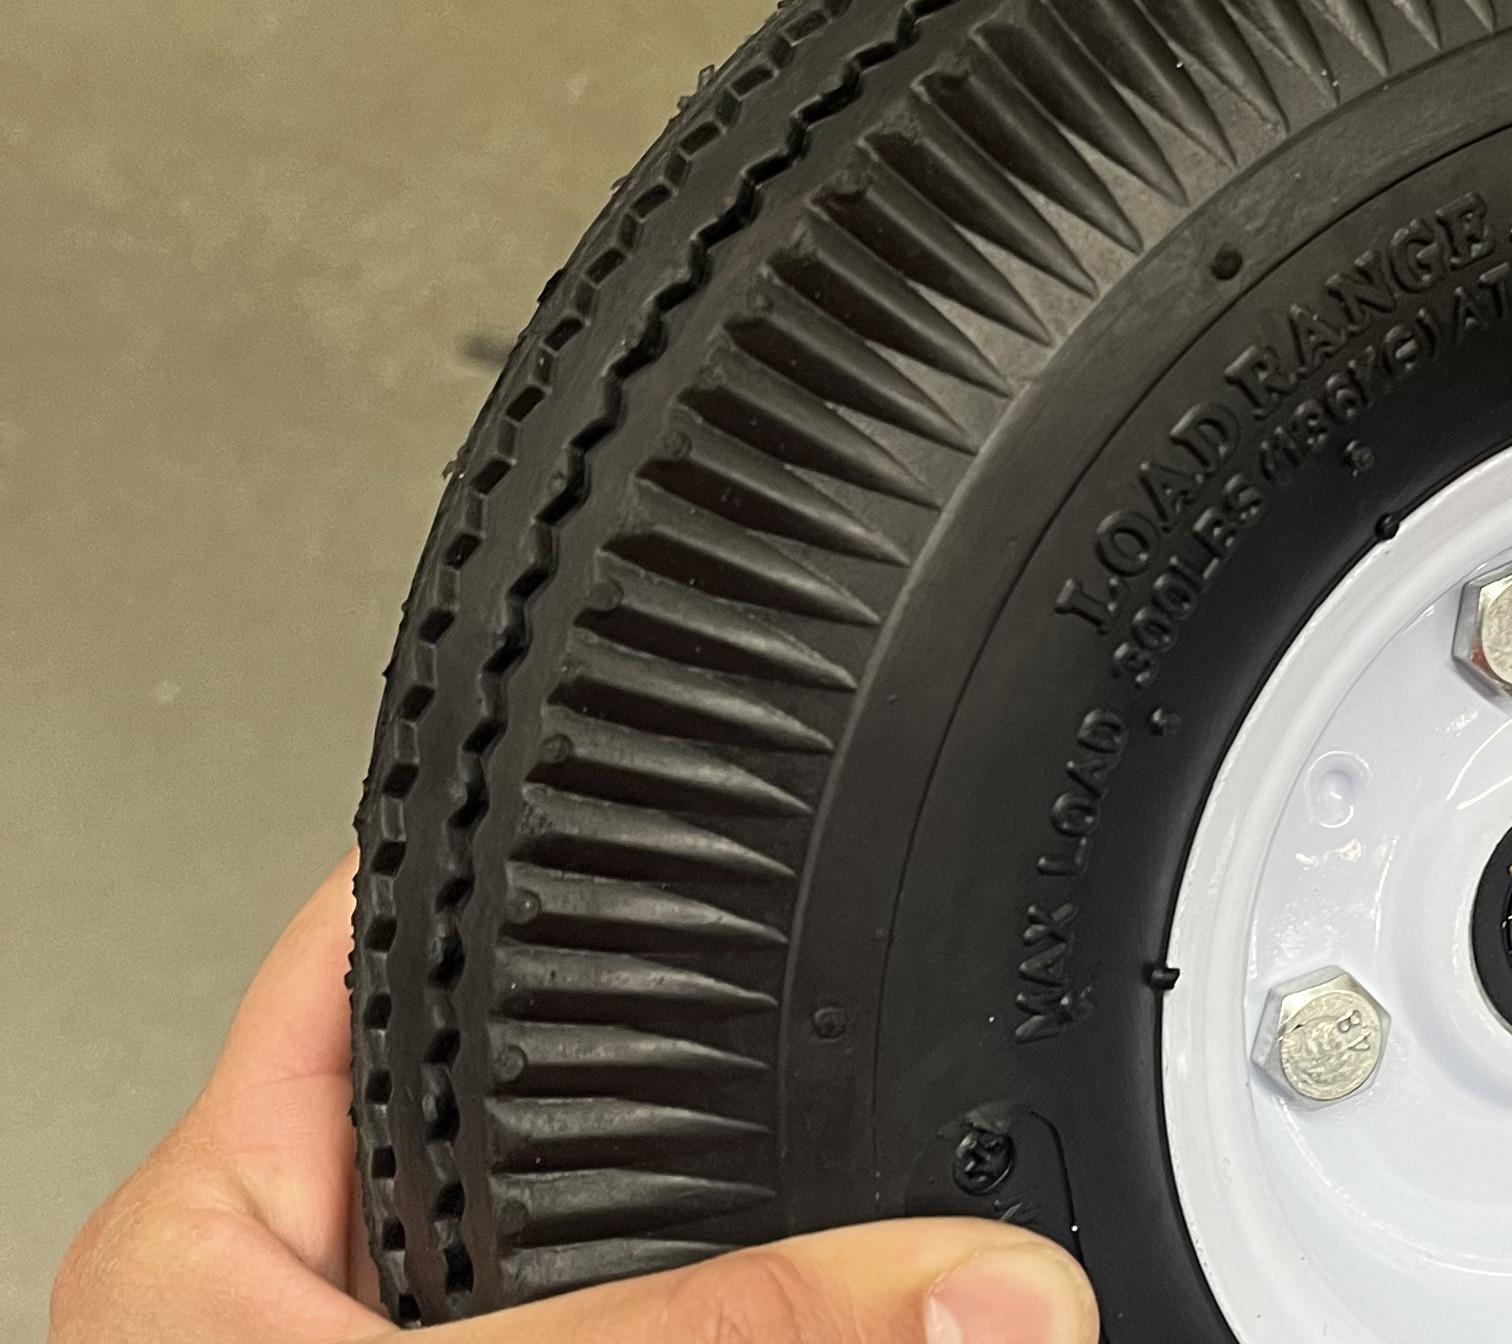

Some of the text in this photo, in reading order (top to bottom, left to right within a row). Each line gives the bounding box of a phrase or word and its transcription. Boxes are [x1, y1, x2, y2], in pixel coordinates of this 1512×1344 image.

[1054, 402, 1241, 635] LOAD
[1223, 191, 1494, 421] RANGE
[1036, 707, 1129, 877] LOAD
